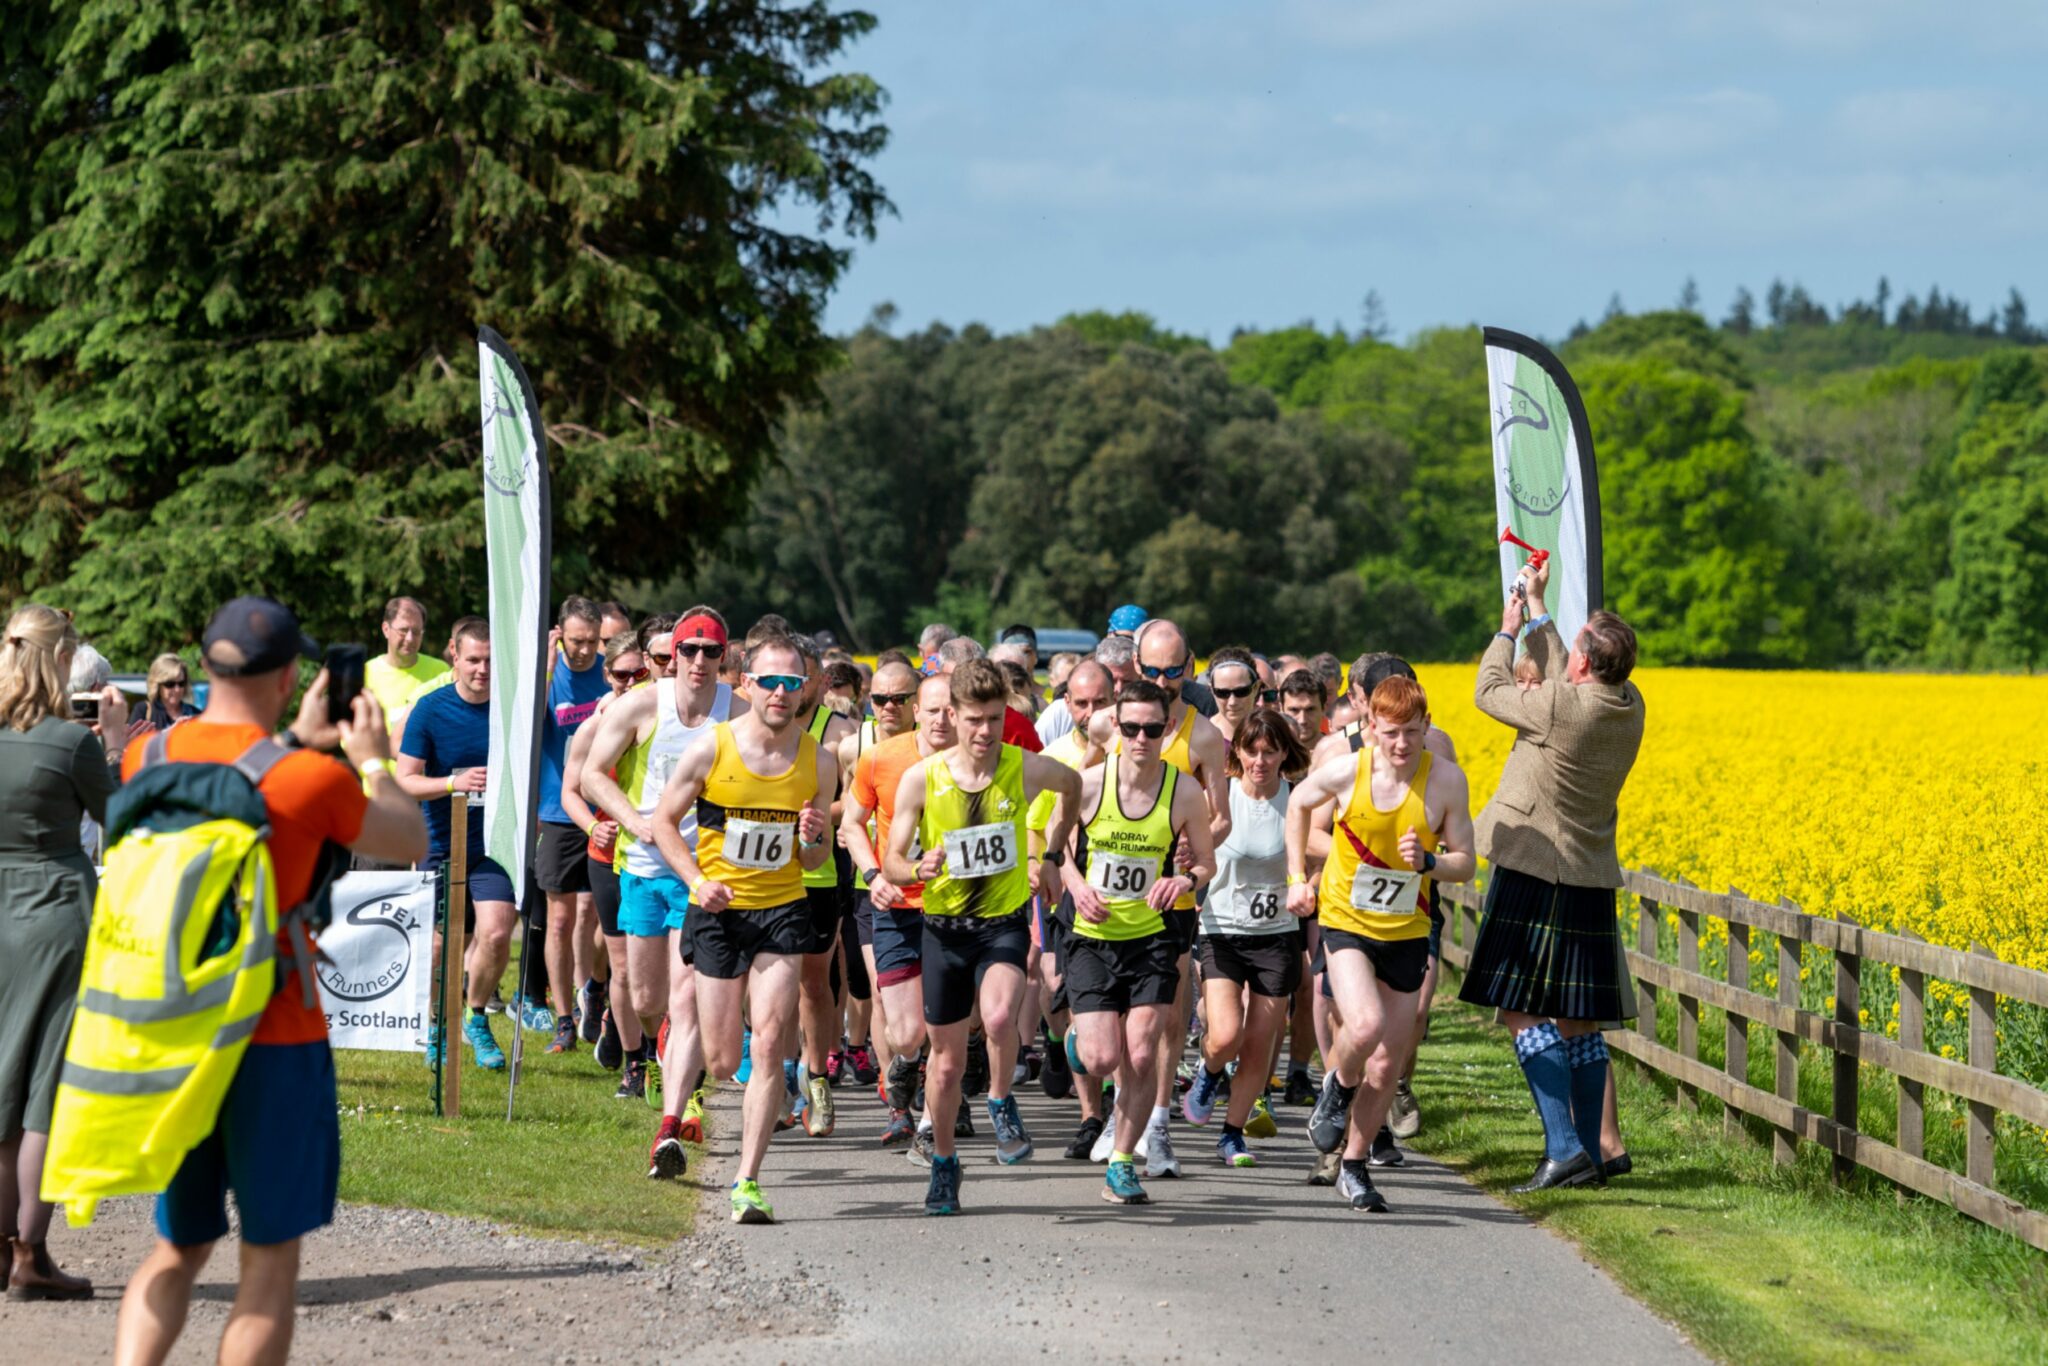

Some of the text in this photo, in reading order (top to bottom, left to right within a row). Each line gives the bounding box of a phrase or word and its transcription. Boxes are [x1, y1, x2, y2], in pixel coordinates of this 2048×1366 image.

[737, 832, 782, 862] 116
[1110, 831, 1149, 842] MORAY
[960, 834, 1007, 869] 148
[1102, 863, 1146, 893] 130
[1369, 878, 1406, 906] 27
[1250, 892, 1278, 920] 68
[328, 960, 404, 995] Runners
[339, 1010, 421, 1030] Scotland
